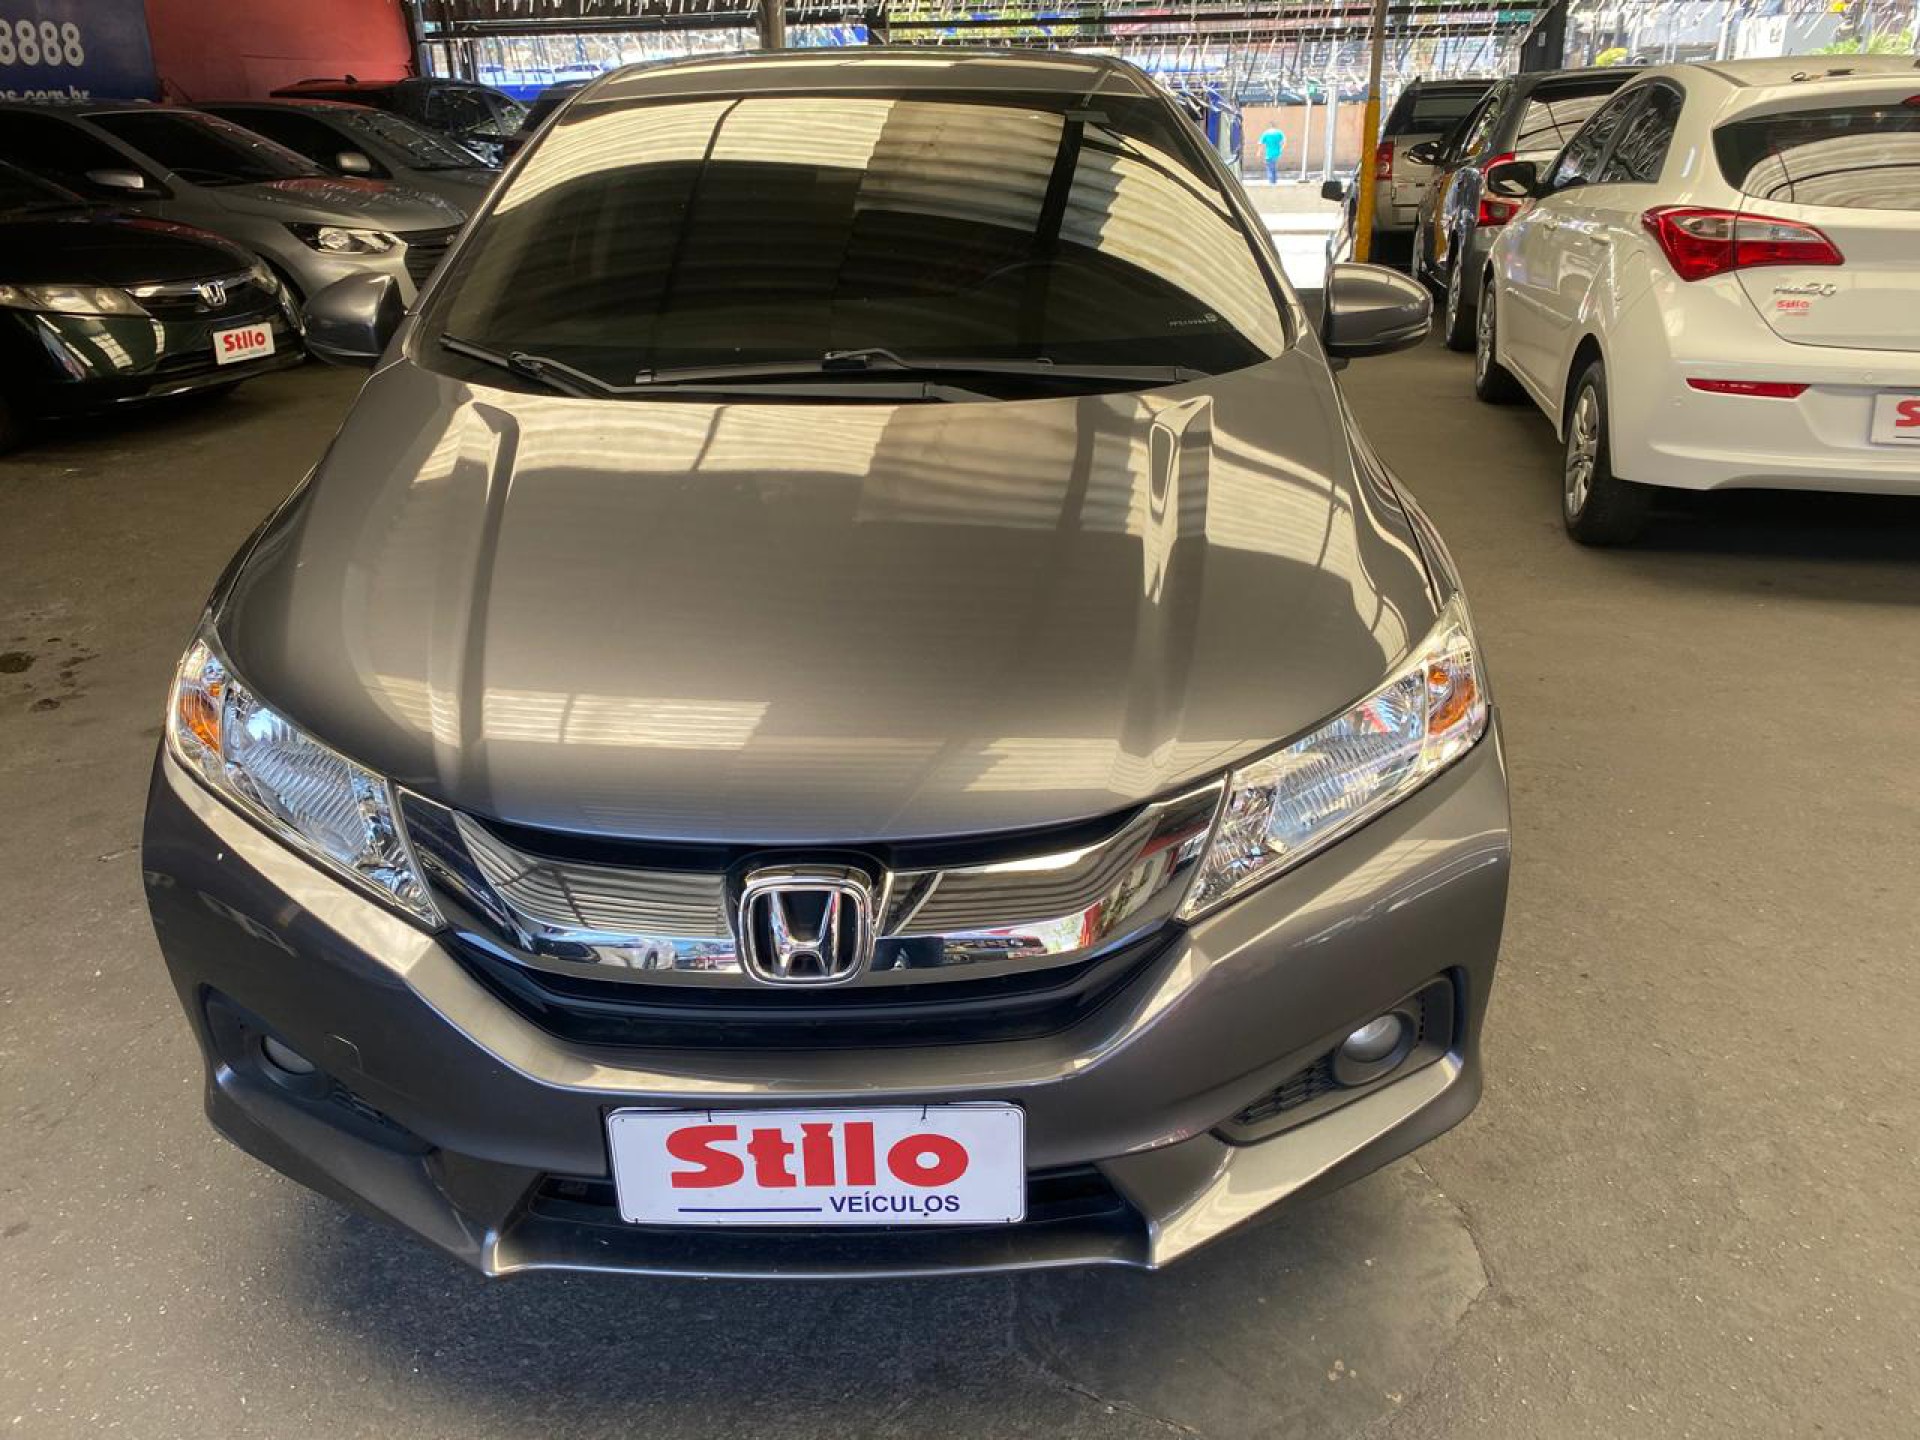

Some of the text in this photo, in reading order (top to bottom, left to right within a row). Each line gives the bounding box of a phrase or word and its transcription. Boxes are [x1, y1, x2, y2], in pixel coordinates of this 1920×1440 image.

[223, 329, 266, 352] Stilo
[665, 1122, 970, 1189] Stilo
[829, 1191, 961, 1213] VEÍCULOS
